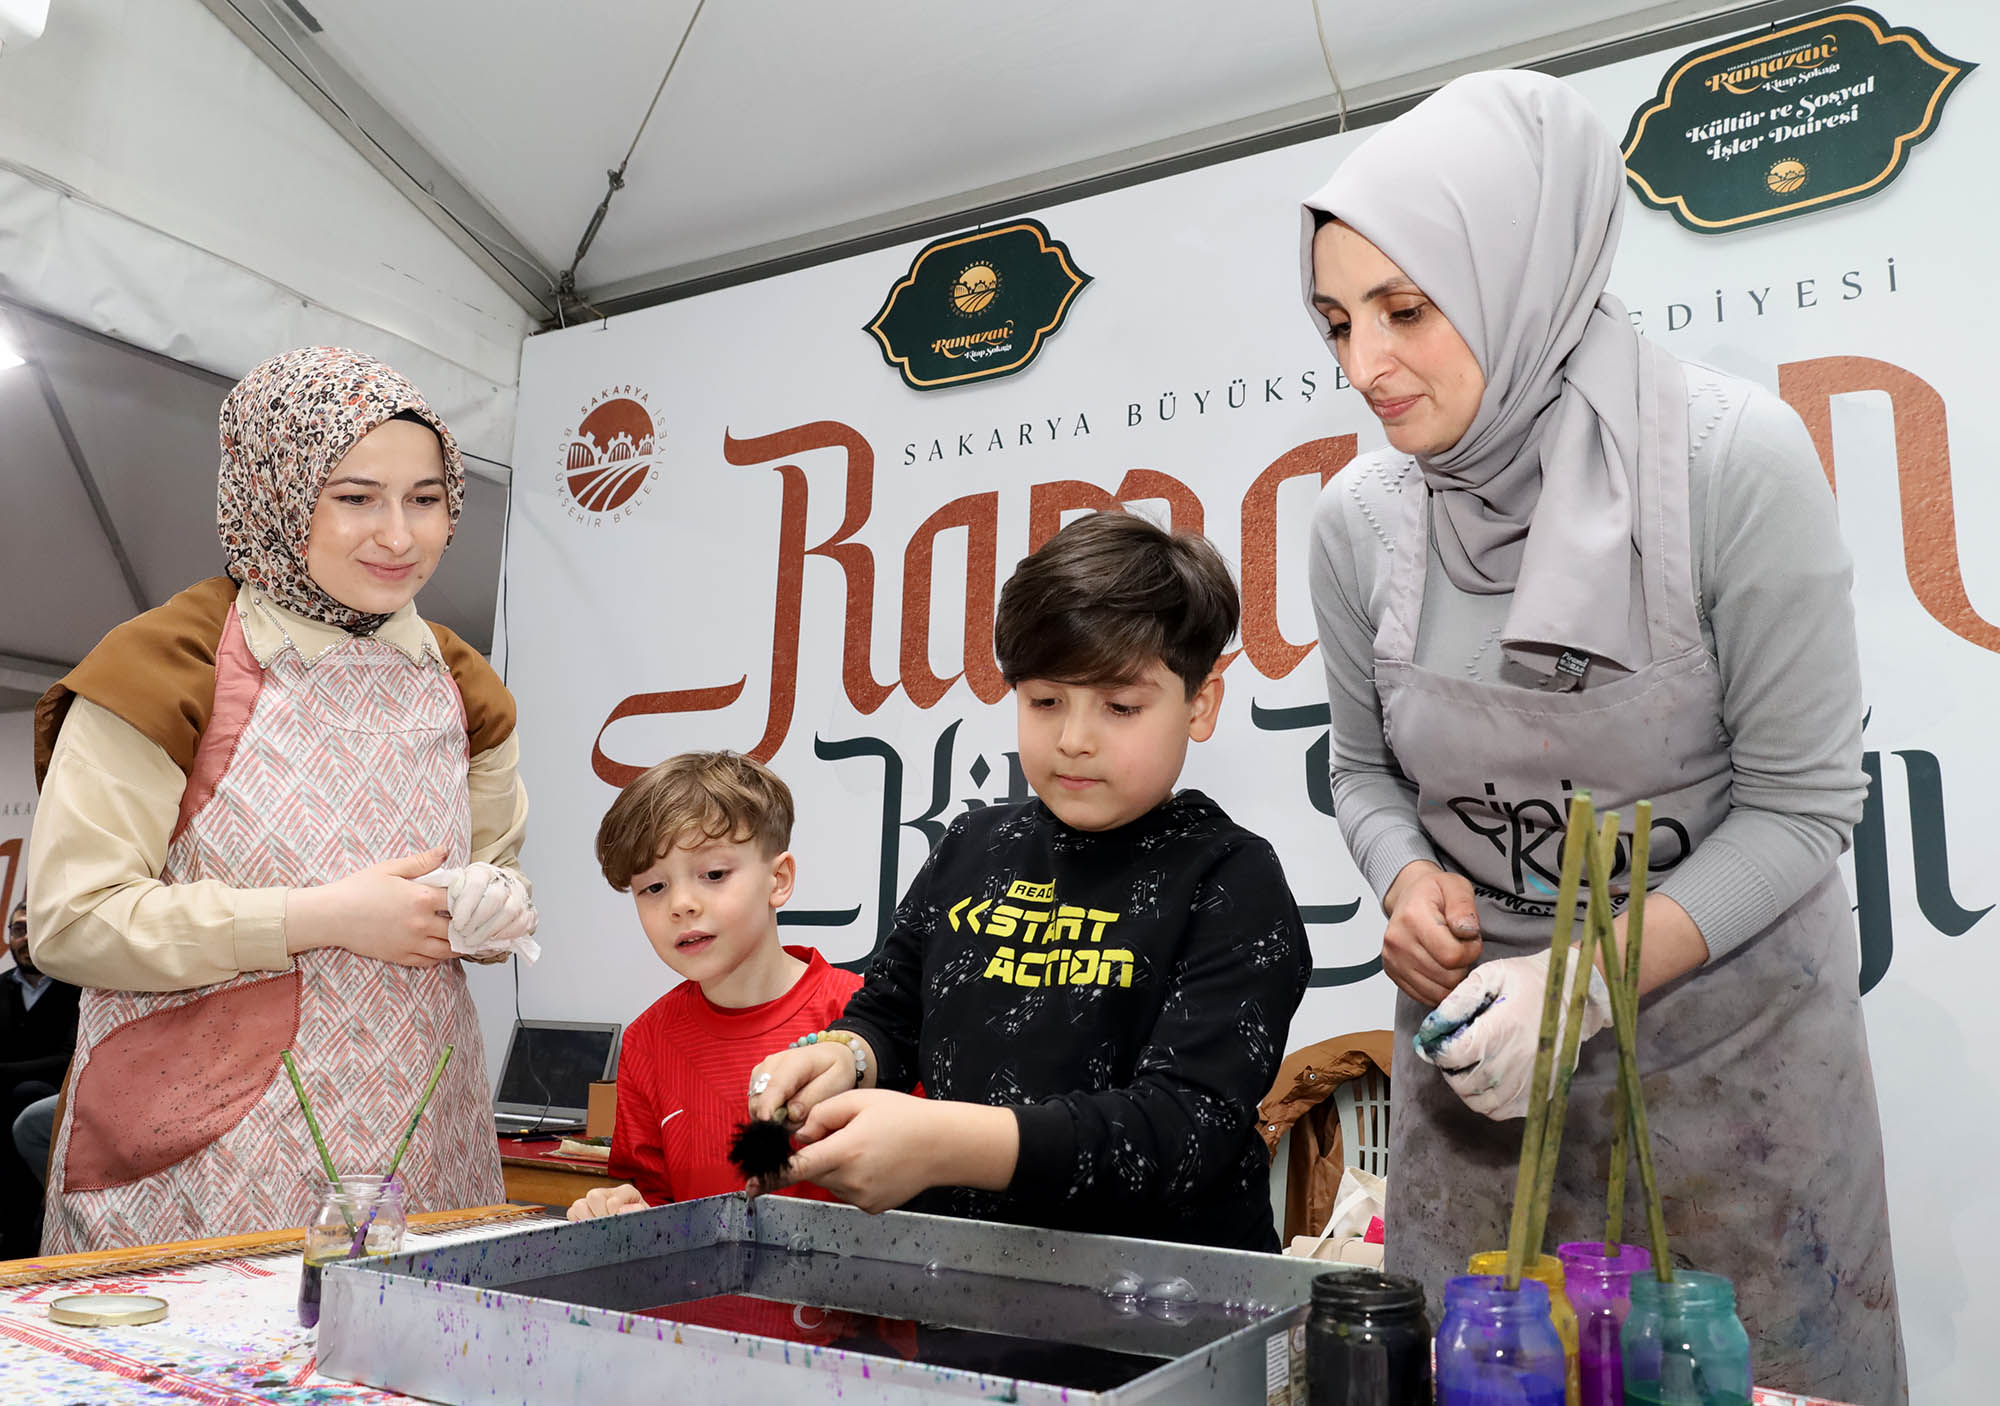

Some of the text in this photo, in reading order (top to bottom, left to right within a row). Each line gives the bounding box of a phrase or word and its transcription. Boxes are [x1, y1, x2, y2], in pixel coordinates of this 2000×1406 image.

[1705, 43, 1838, 95] Ramazan
[1762, 75, 1797, 93] Kitap
[1686, 75, 1875, 144] Kültür ve Sosyal
[1706, 104, 1860, 161] İşler Dairesi
[931, 327, 1014, 360] Ramazan
[580, 384, 649, 415] SAKARYA
[903, 412, 1091, 467] SAKARYA
[1127, 365, 1351, 427] BÜYÜKŞE
[984, 904, 1121, 945] START
[983, 946, 1135, 988] ACTION
